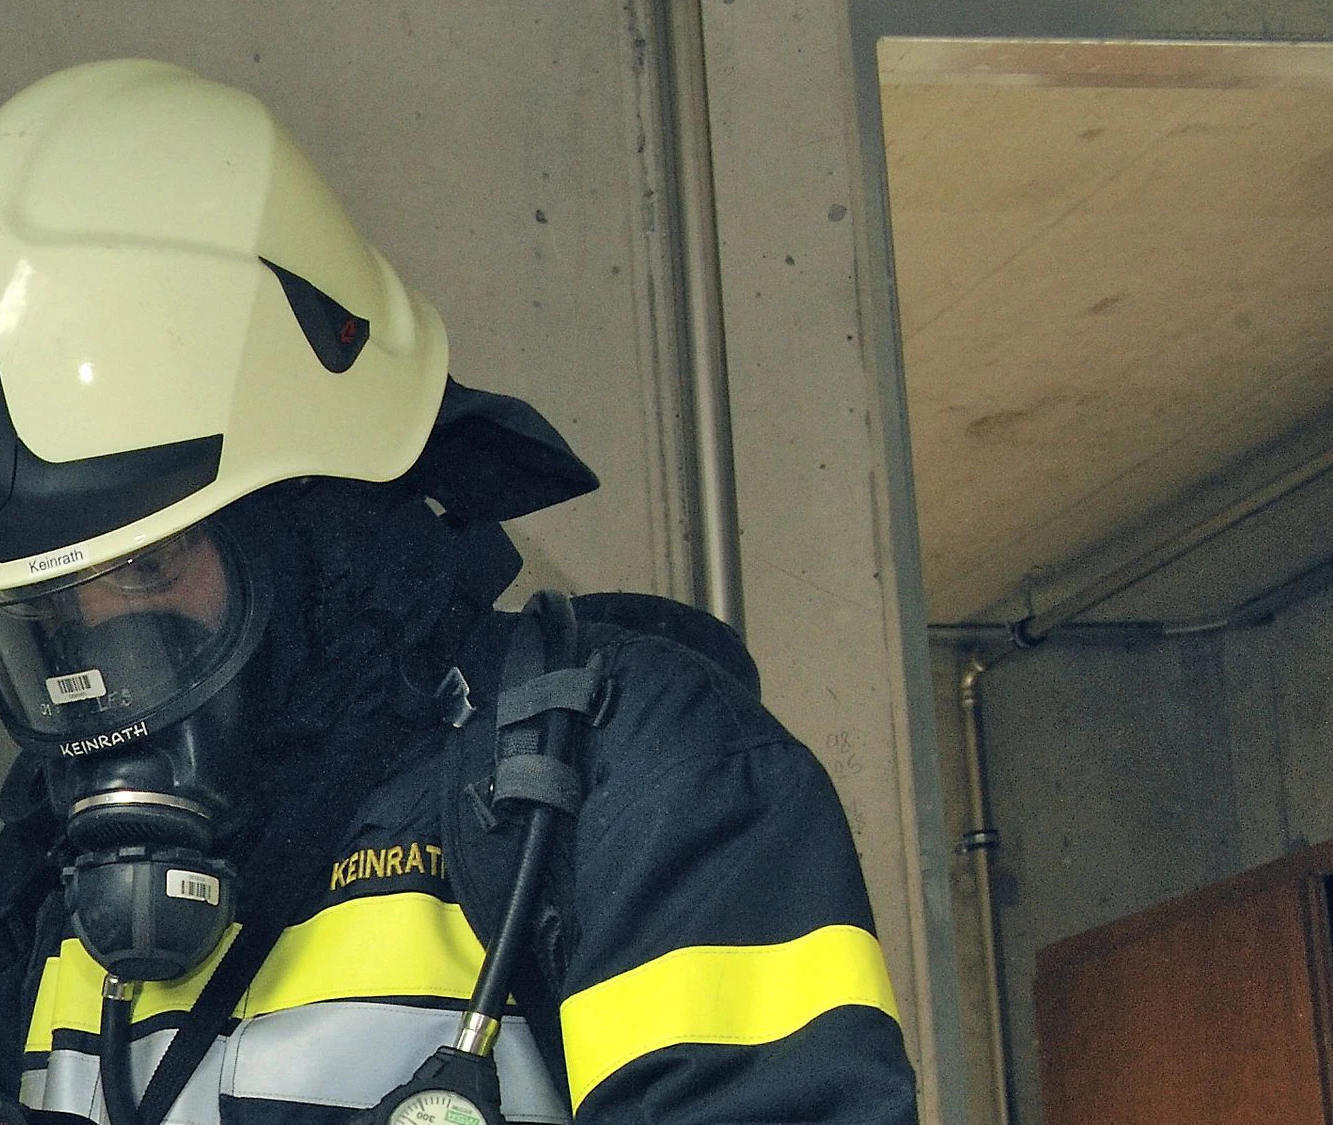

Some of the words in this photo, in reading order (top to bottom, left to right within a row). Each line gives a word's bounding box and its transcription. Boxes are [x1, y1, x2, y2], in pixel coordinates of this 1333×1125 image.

[28, 550, 84, 573] Keinrath
[59, 721, 148, 757] KEINRATH
[416, 1111, 436, 1123] 300
